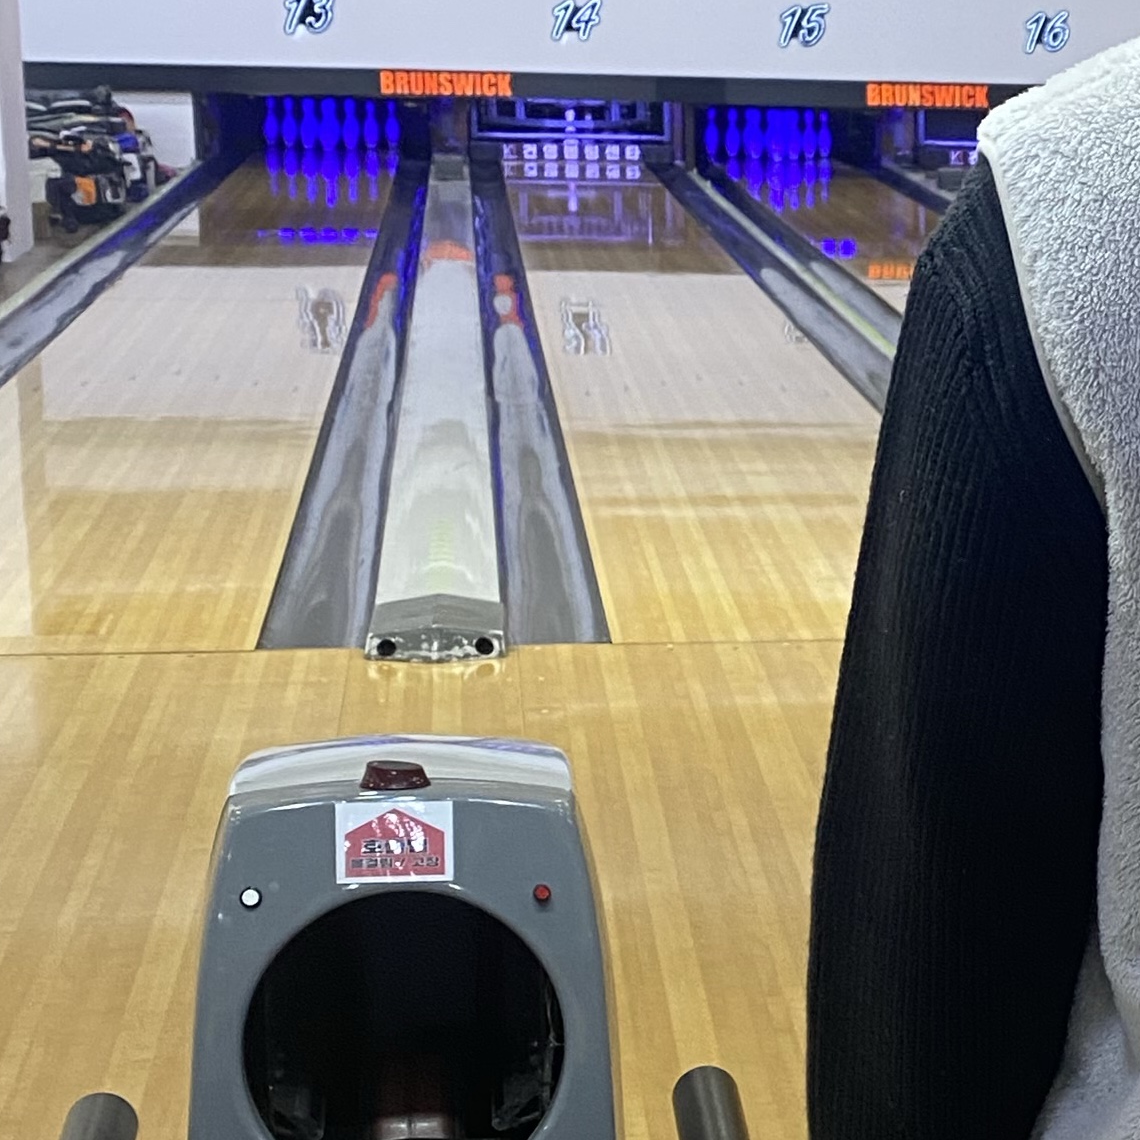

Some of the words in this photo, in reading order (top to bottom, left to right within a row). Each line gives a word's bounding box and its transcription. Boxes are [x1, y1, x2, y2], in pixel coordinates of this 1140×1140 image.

[779, 3, 830, 48] 15
[1024, 10, 1070, 54] 16
[380, 70, 512, 97] BRUNSWICK
[866, 83, 989, 108] BRUNSWICK
